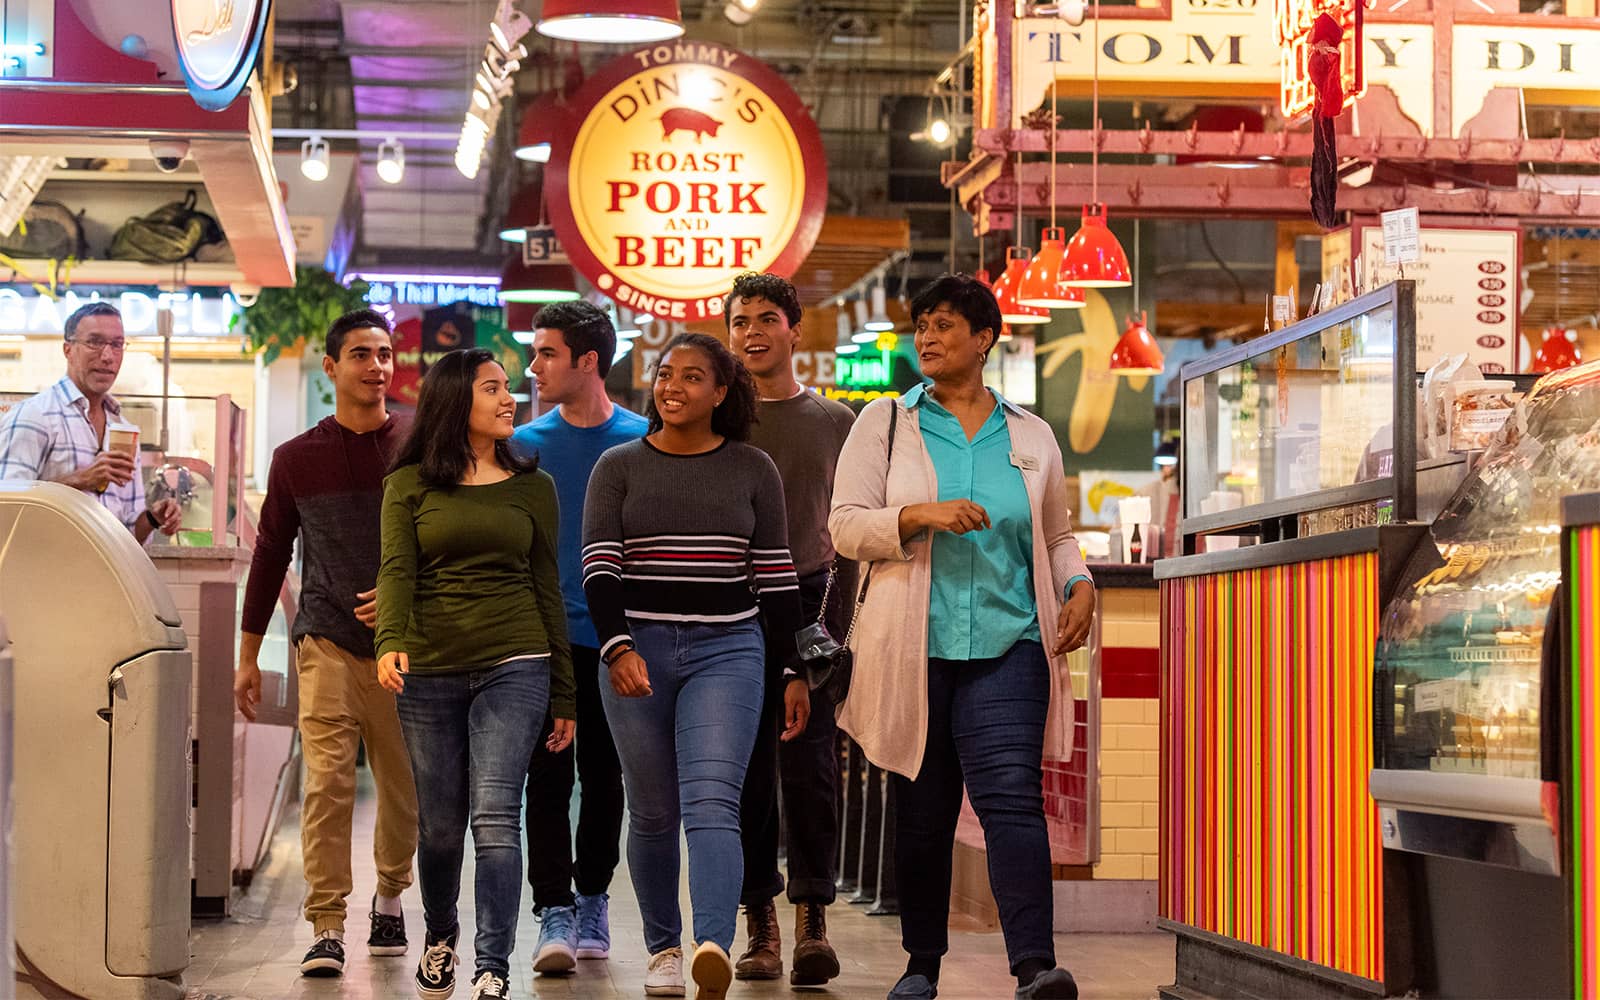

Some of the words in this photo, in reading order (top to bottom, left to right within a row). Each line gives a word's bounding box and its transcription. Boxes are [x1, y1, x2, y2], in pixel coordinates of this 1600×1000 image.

[634, 44, 739, 68] TOMMY
[1029, 32, 1411, 68] TOMY
[631, 151, 744, 173] ROAST
[605, 181, 767, 214] PORK
[664, 218, 709, 231] AND
[614, 235, 762, 268] BEEF
[120, 291, 232, 334] DELI
[616, 284, 686, 318] SINCE
[1416, 294, 1454, 304] AUSAGE
